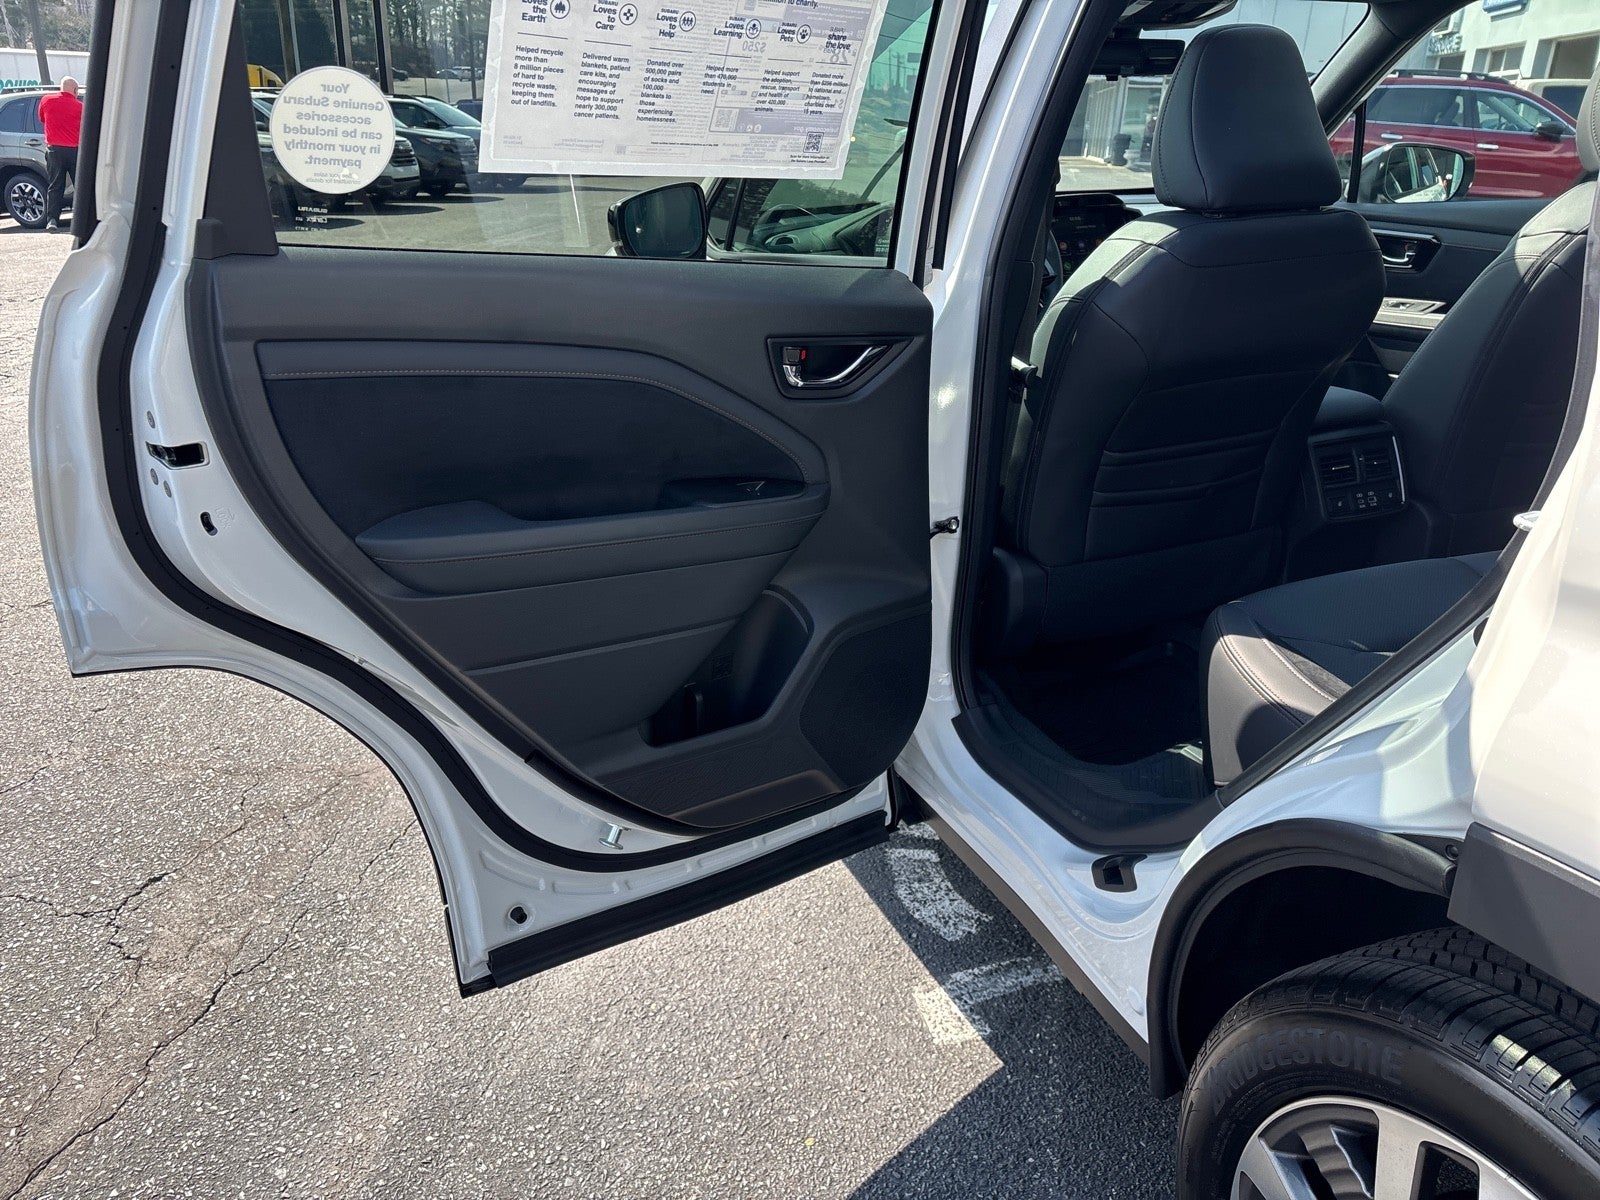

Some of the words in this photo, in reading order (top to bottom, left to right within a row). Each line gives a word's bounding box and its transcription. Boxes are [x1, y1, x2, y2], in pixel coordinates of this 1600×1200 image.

[533, 5, 546, 14] the
[593, 4, 617, 15] Loves
[522, 12, 546, 23] Earth
[608, 15, 615, 23] to
[656, 13, 677, 22] Loves
[596, 21, 614, 30] Care
[725, 21, 744, 30] Loves
[659, 29, 675, 39] Help
[714, 28, 743, 39] Learning
[777, 27, 796, 35] Loves
[827, 33, 847, 41] share
[837, 42, 850, 50] love
[516, 45, 539, 53] Helped
[541, 48, 563, 57] recycle
[582, 53, 611, 61] Delivered
[581, 62, 608, 70] blankets,
[647, 59, 670, 67] Donated
[512, 81, 535, 89] recycle
[578, 79, 616, 88] encouraging
[512, 90, 536, 98] keeping
[577, 86, 607, 95] messages
[595, 112, 620, 120] patients.
[638, 108, 673, 116] experiencing
